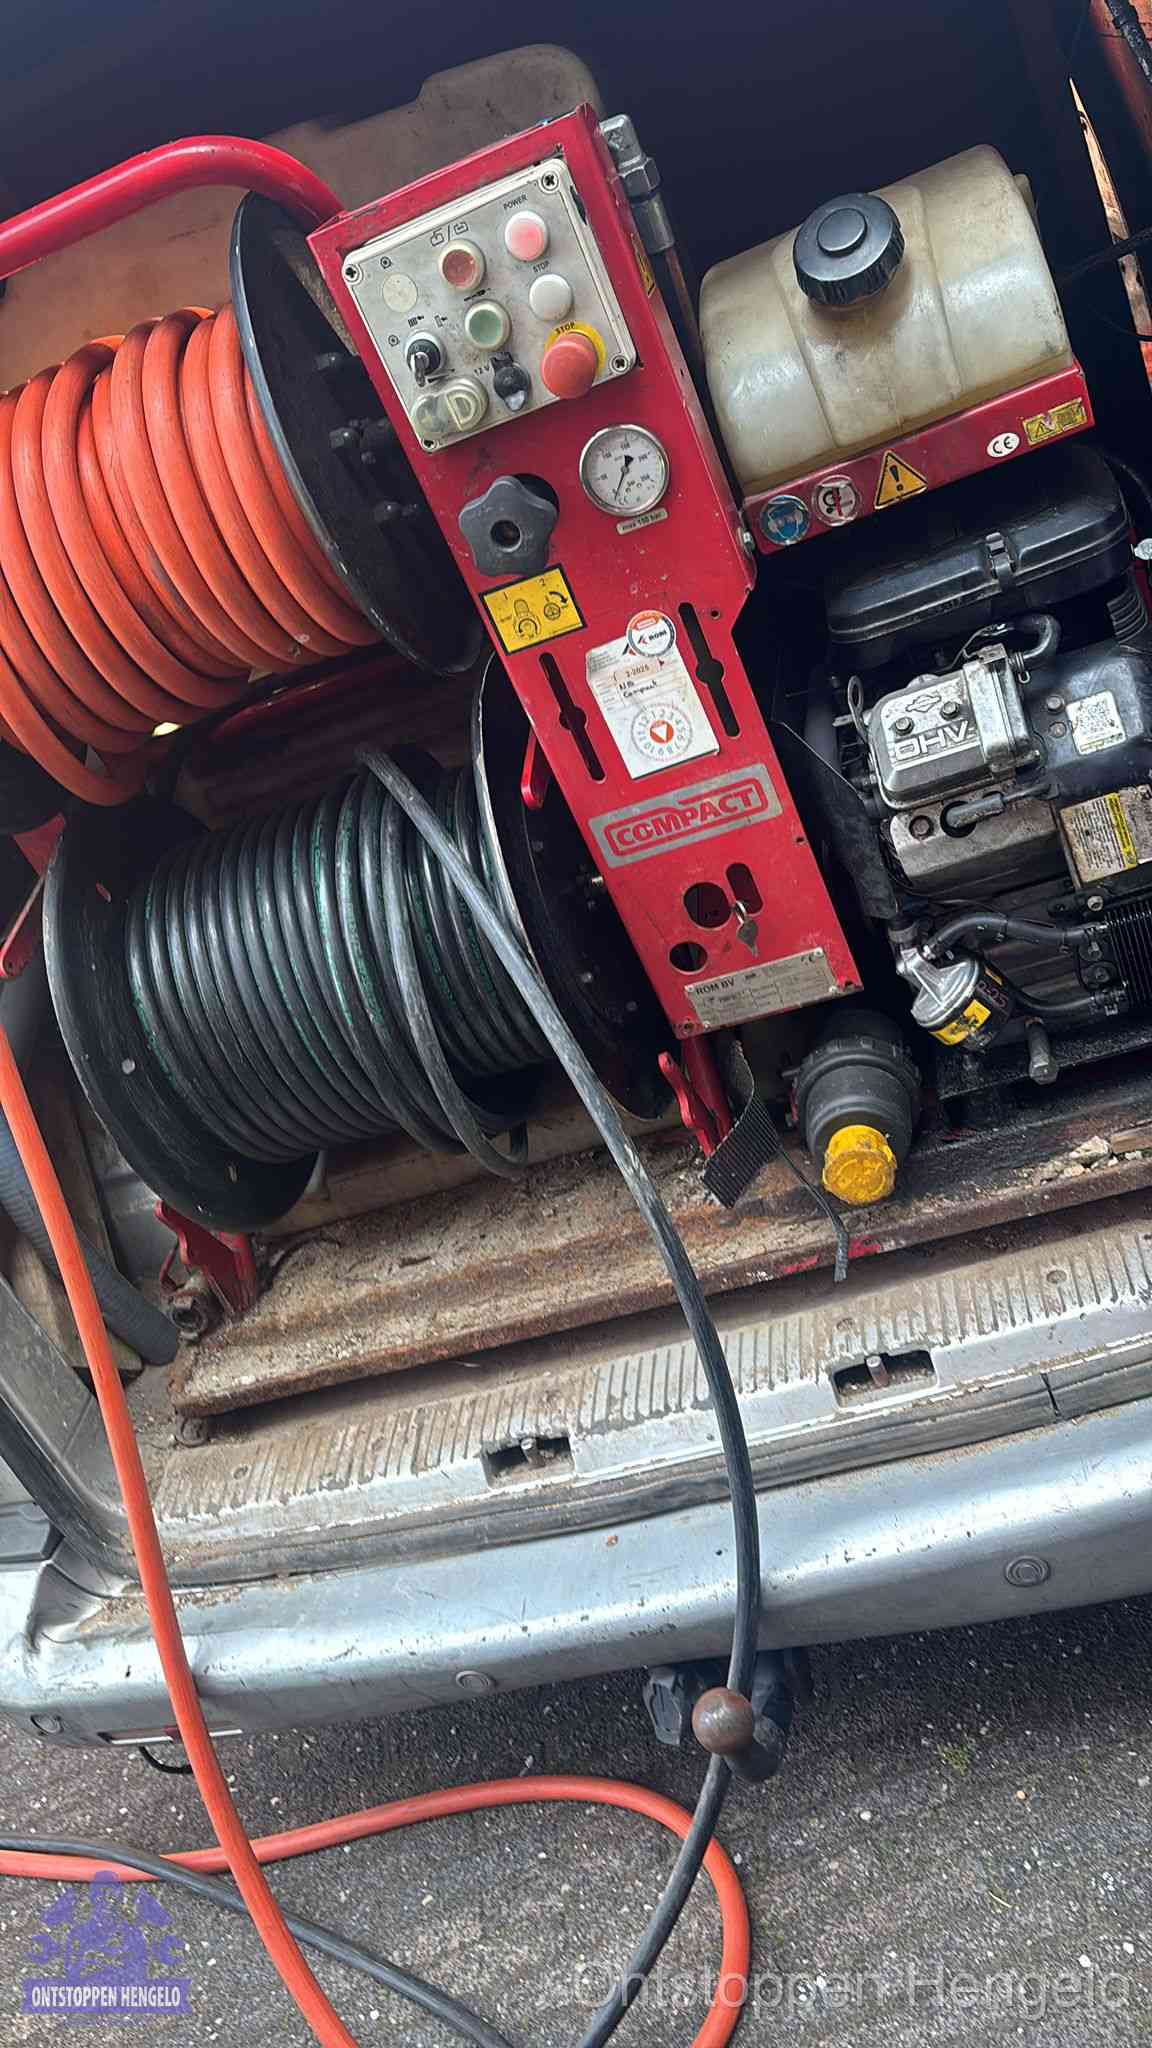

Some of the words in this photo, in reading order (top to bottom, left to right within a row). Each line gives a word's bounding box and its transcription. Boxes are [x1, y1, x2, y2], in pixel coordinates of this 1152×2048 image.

[503, 193, 528, 210] POWER
[532, 260, 550, 273] STOP
[554, 322, 576, 335] STOP
[992, 435, 1014, 455] CE
[616, 788, 754, 847] COMPACT
[721, 977, 736, 990] BV
